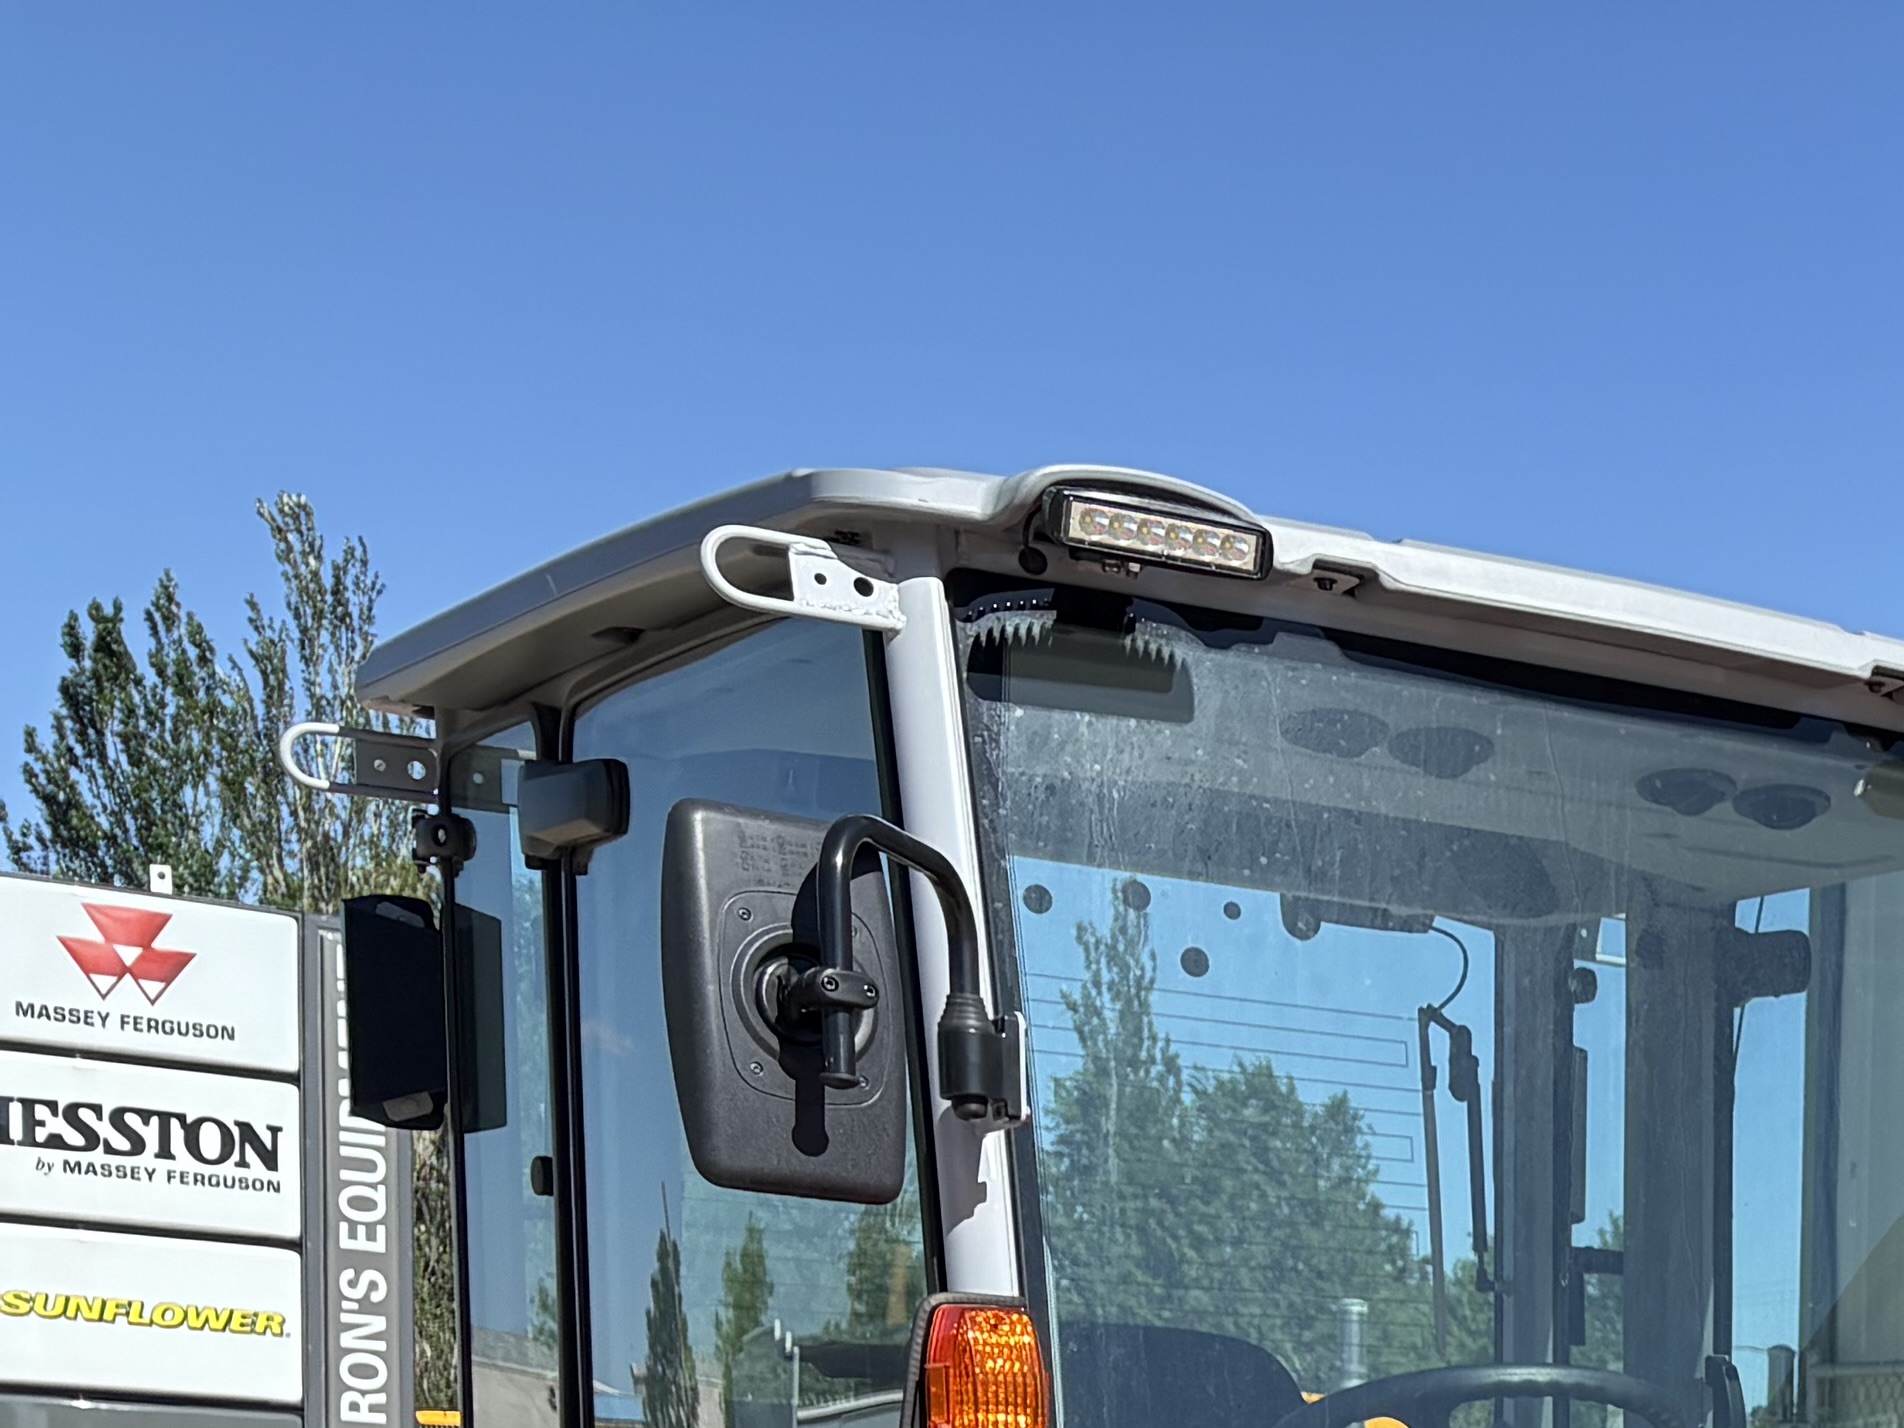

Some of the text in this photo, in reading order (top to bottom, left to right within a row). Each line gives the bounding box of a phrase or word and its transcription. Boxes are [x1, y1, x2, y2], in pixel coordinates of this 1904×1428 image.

[15, 1000, 236, 1041] MASSEY FERGUSON
[35, 1156, 282, 1194] by MASSEY FERGUSON
[0, 1289, 286, 1338] SUNFLOWER
[338, 1267, 389, 1425] RON'S
